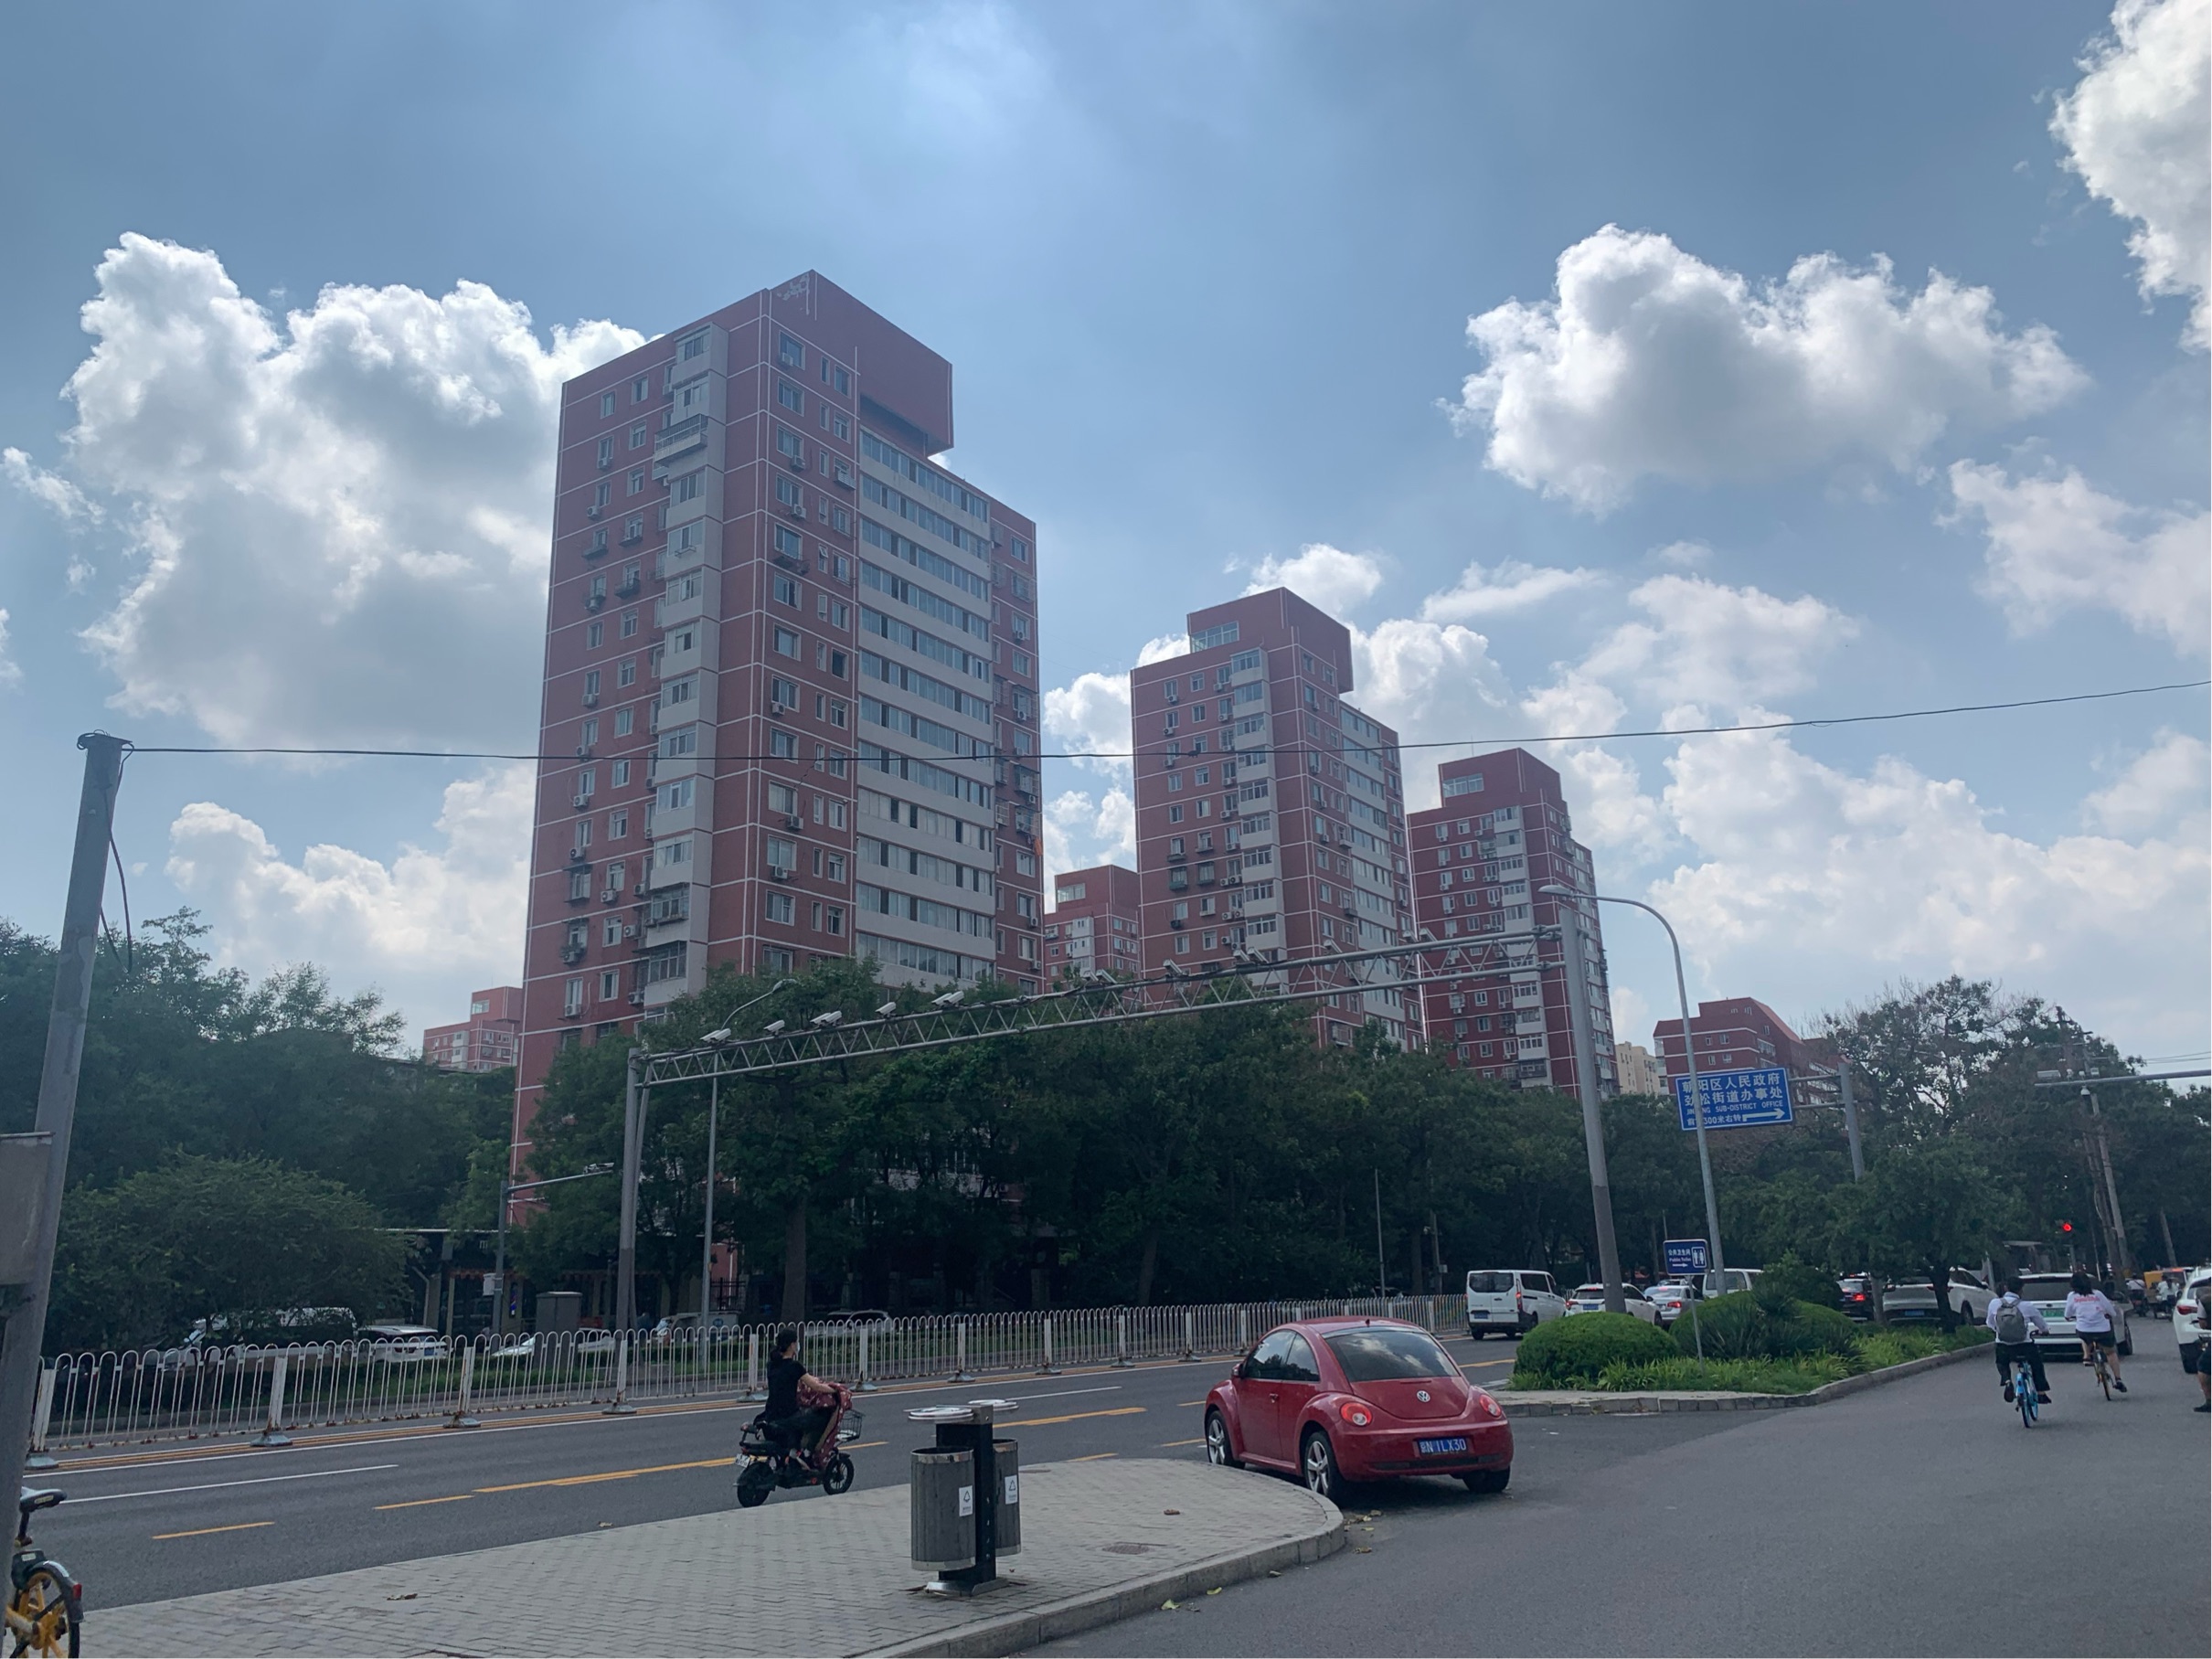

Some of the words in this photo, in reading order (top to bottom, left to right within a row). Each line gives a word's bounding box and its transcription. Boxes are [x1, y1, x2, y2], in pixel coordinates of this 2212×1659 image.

[1682, 1072, 1780, 1093] 朝阳区人民政府
[1716, 1102, 1757, 1112] SUB-DISTRICT
[1761, 1100, 1783, 1108] OFFICE
[1687, 1113, 1741, 1126] 前300米右转
